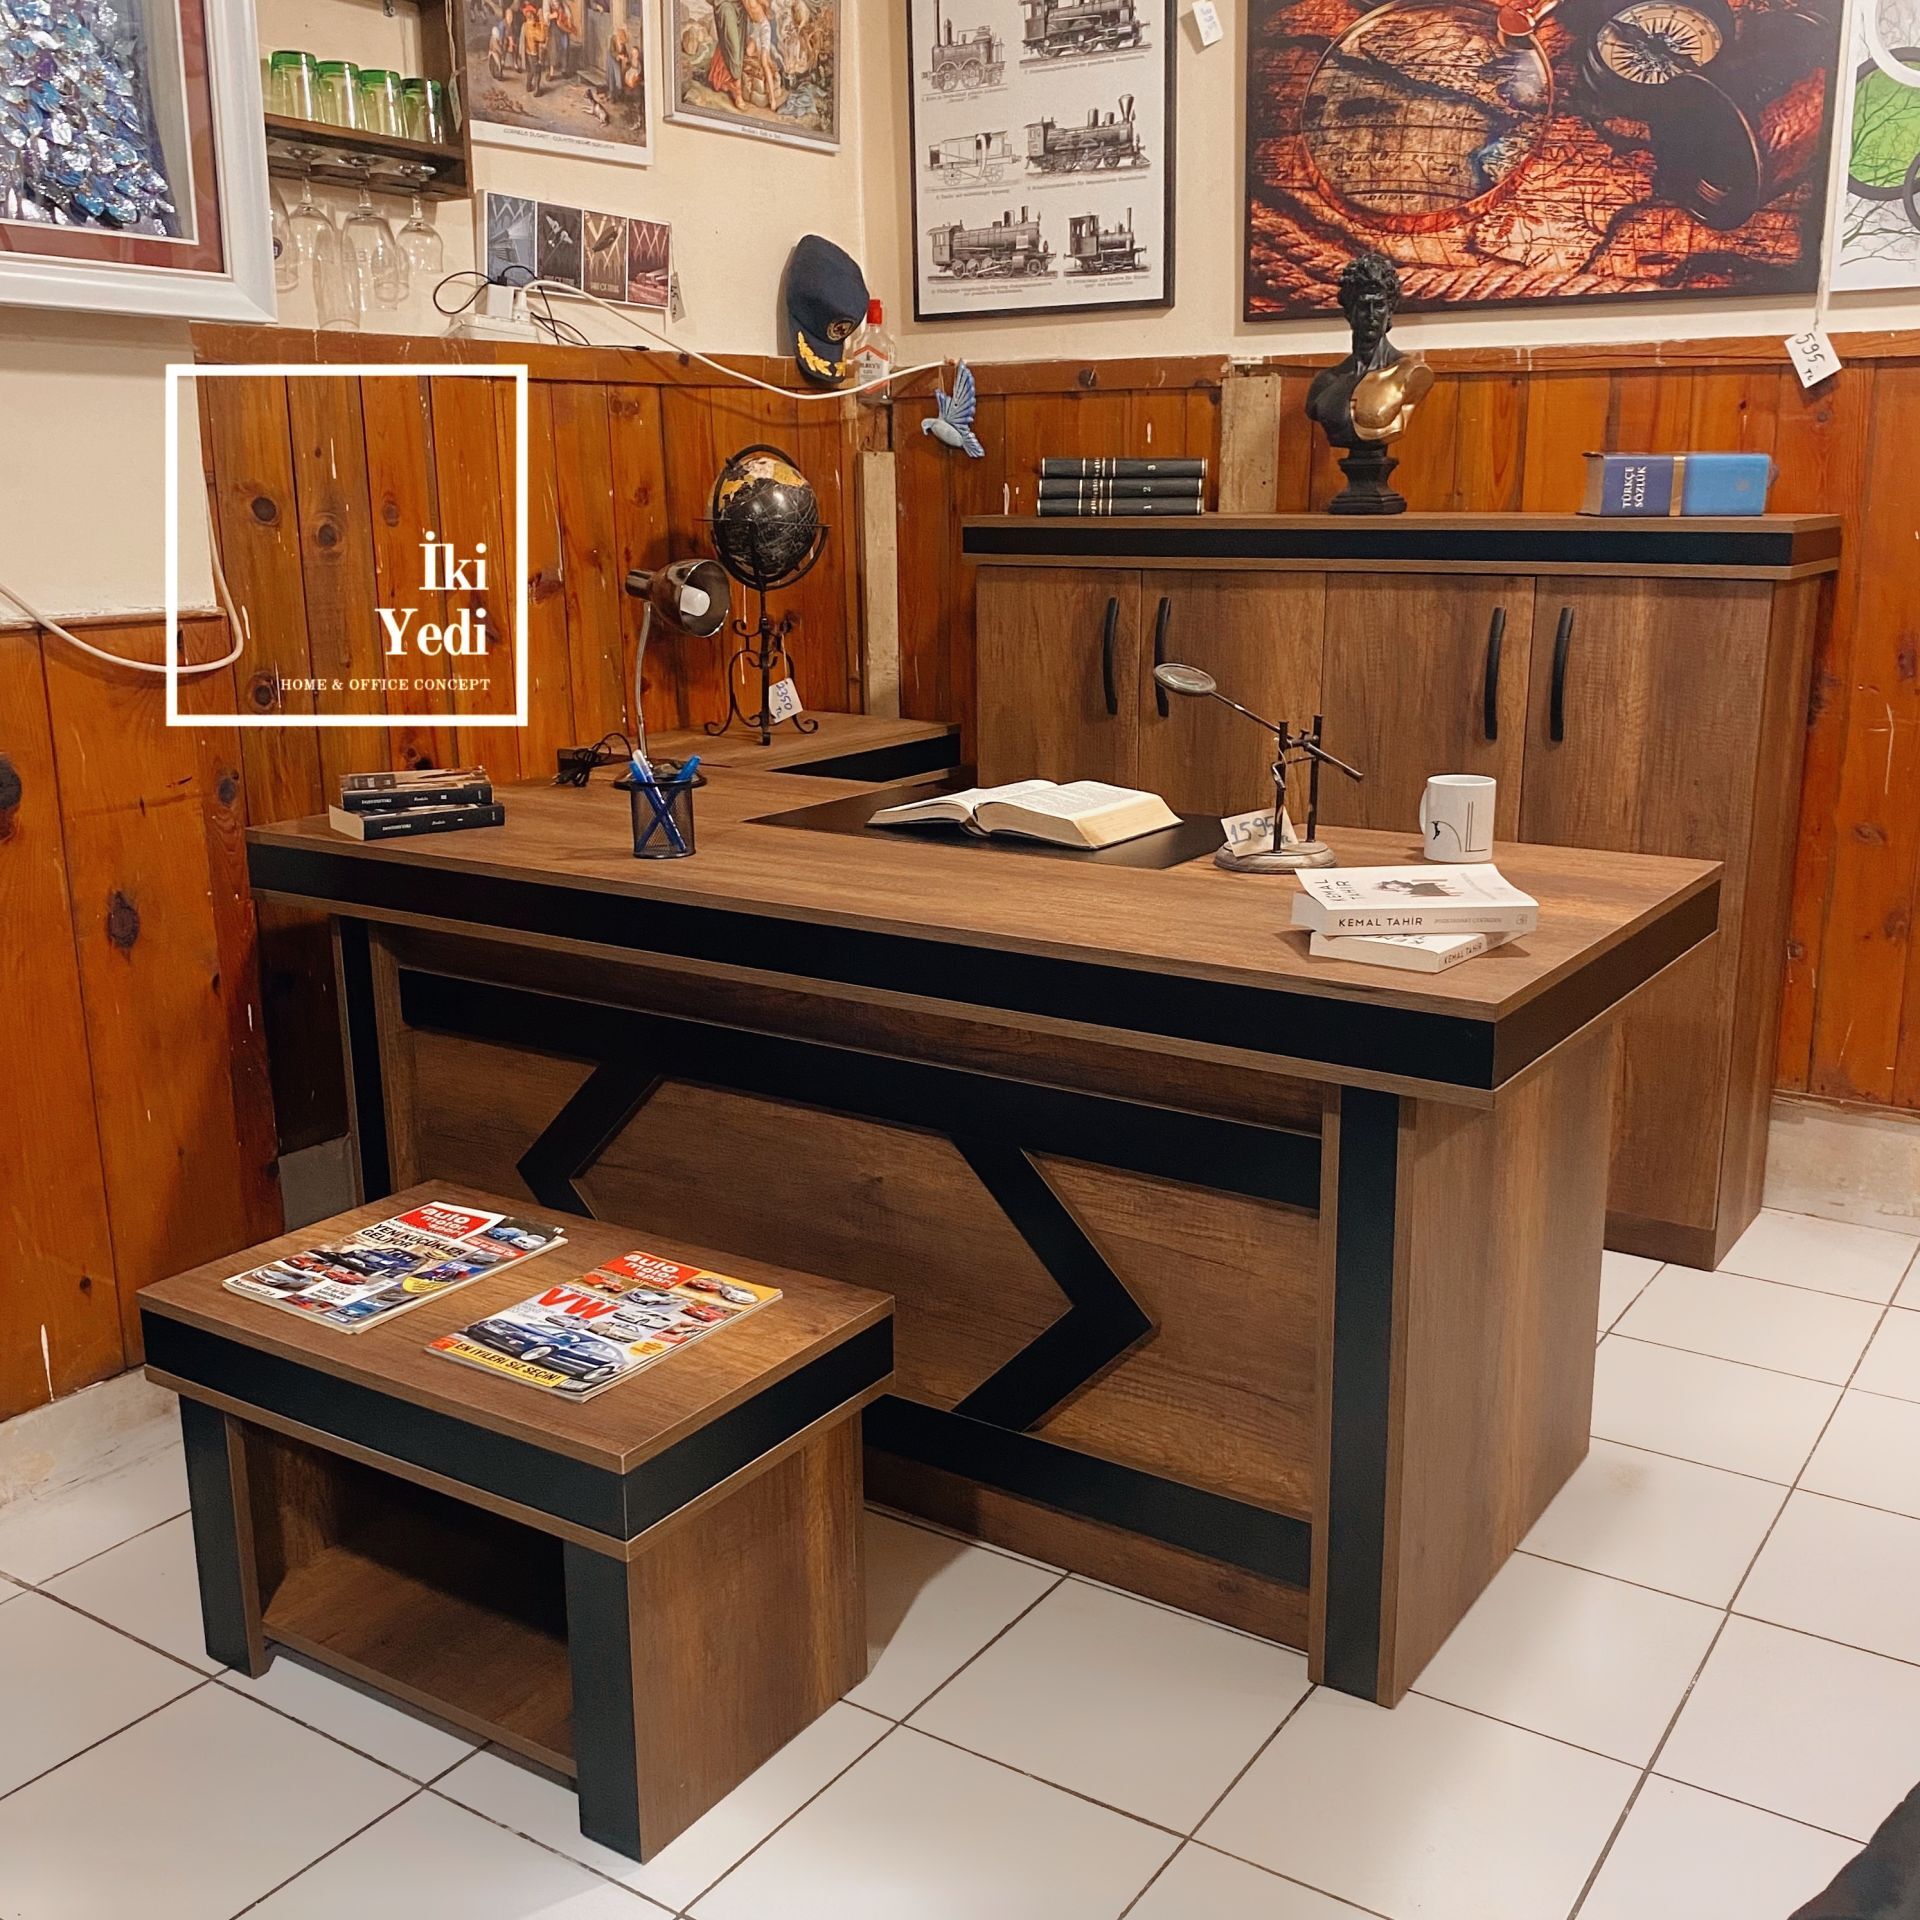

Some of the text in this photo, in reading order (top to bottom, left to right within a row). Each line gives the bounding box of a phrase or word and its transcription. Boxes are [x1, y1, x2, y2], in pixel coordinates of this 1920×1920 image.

[1795, 332, 1825, 363] 595
[1622, 466, 1636, 509] TÜRKÇE
[1633, 466, 1647, 508] SÖZLÜK
[1230, 815, 1275, 845] 1595
[1338, 918, 1382, 927] KEMAL
[1386, 916, 1423, 927] TAHİR
[420, 1215, 470, 1232] motor
[421, 1207, 471, 1225] auto
[428, 1223, 467, 1237] sport
[624, 1254, 679, 1274] auto
[625, 1262, 680, 1280] motor
[633, 1270, 677, 1287] sport
[538, 1287, 621, 1320] VW
[455, 1342, 471, 1351] EN
